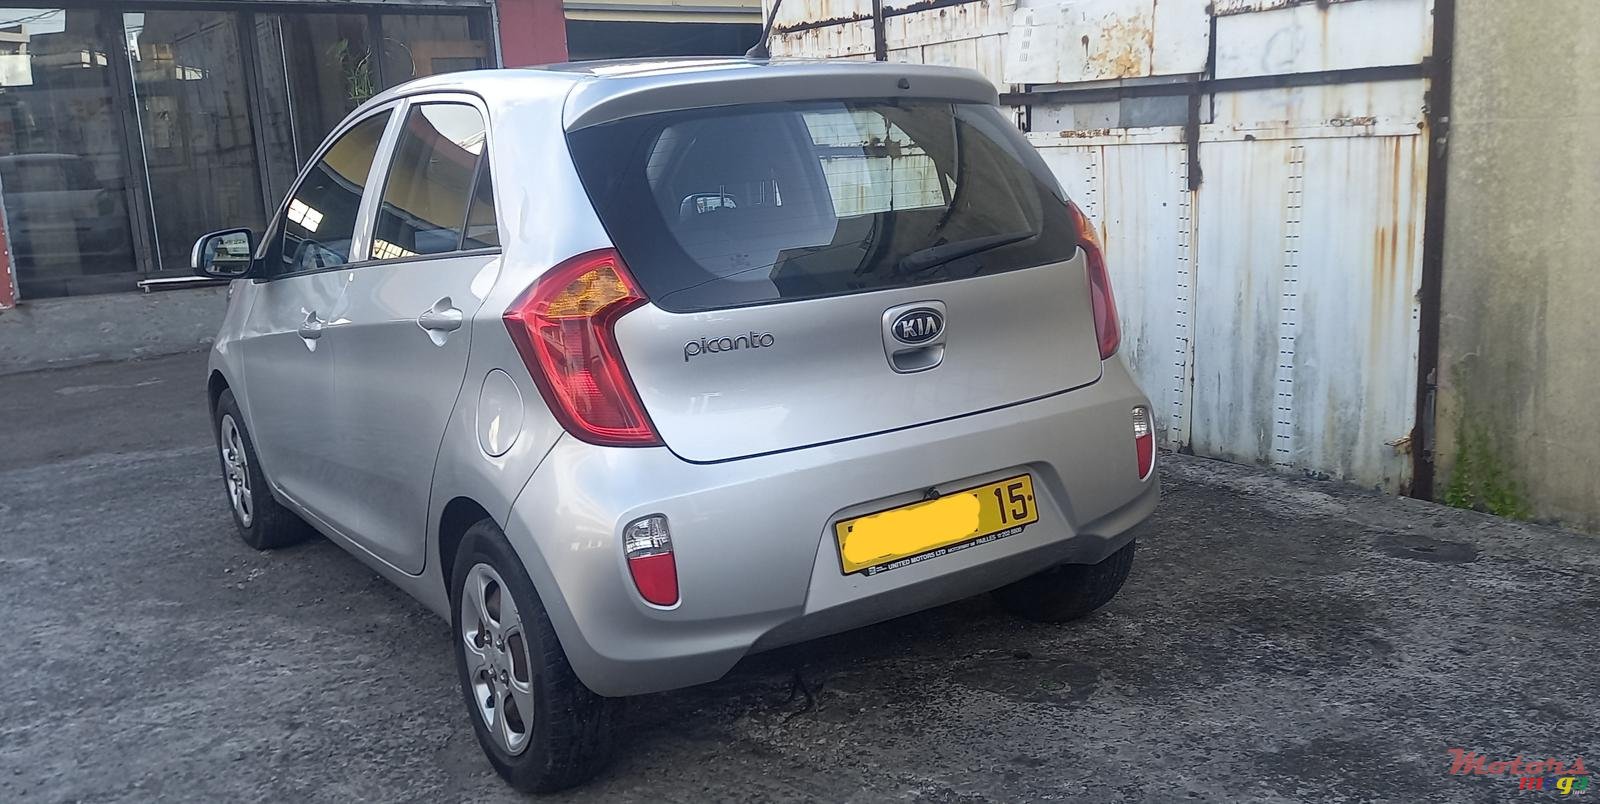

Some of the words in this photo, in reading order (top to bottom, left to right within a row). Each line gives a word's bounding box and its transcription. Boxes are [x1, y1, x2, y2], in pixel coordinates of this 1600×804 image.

[901, 316, 938, 338] KIA
[684, 331, 775, 362] picanto
[994, 482, 1028, 524] 15
[888, 558, 910, 569] UNITED
[911, 552, 935, 564] MOTORS
